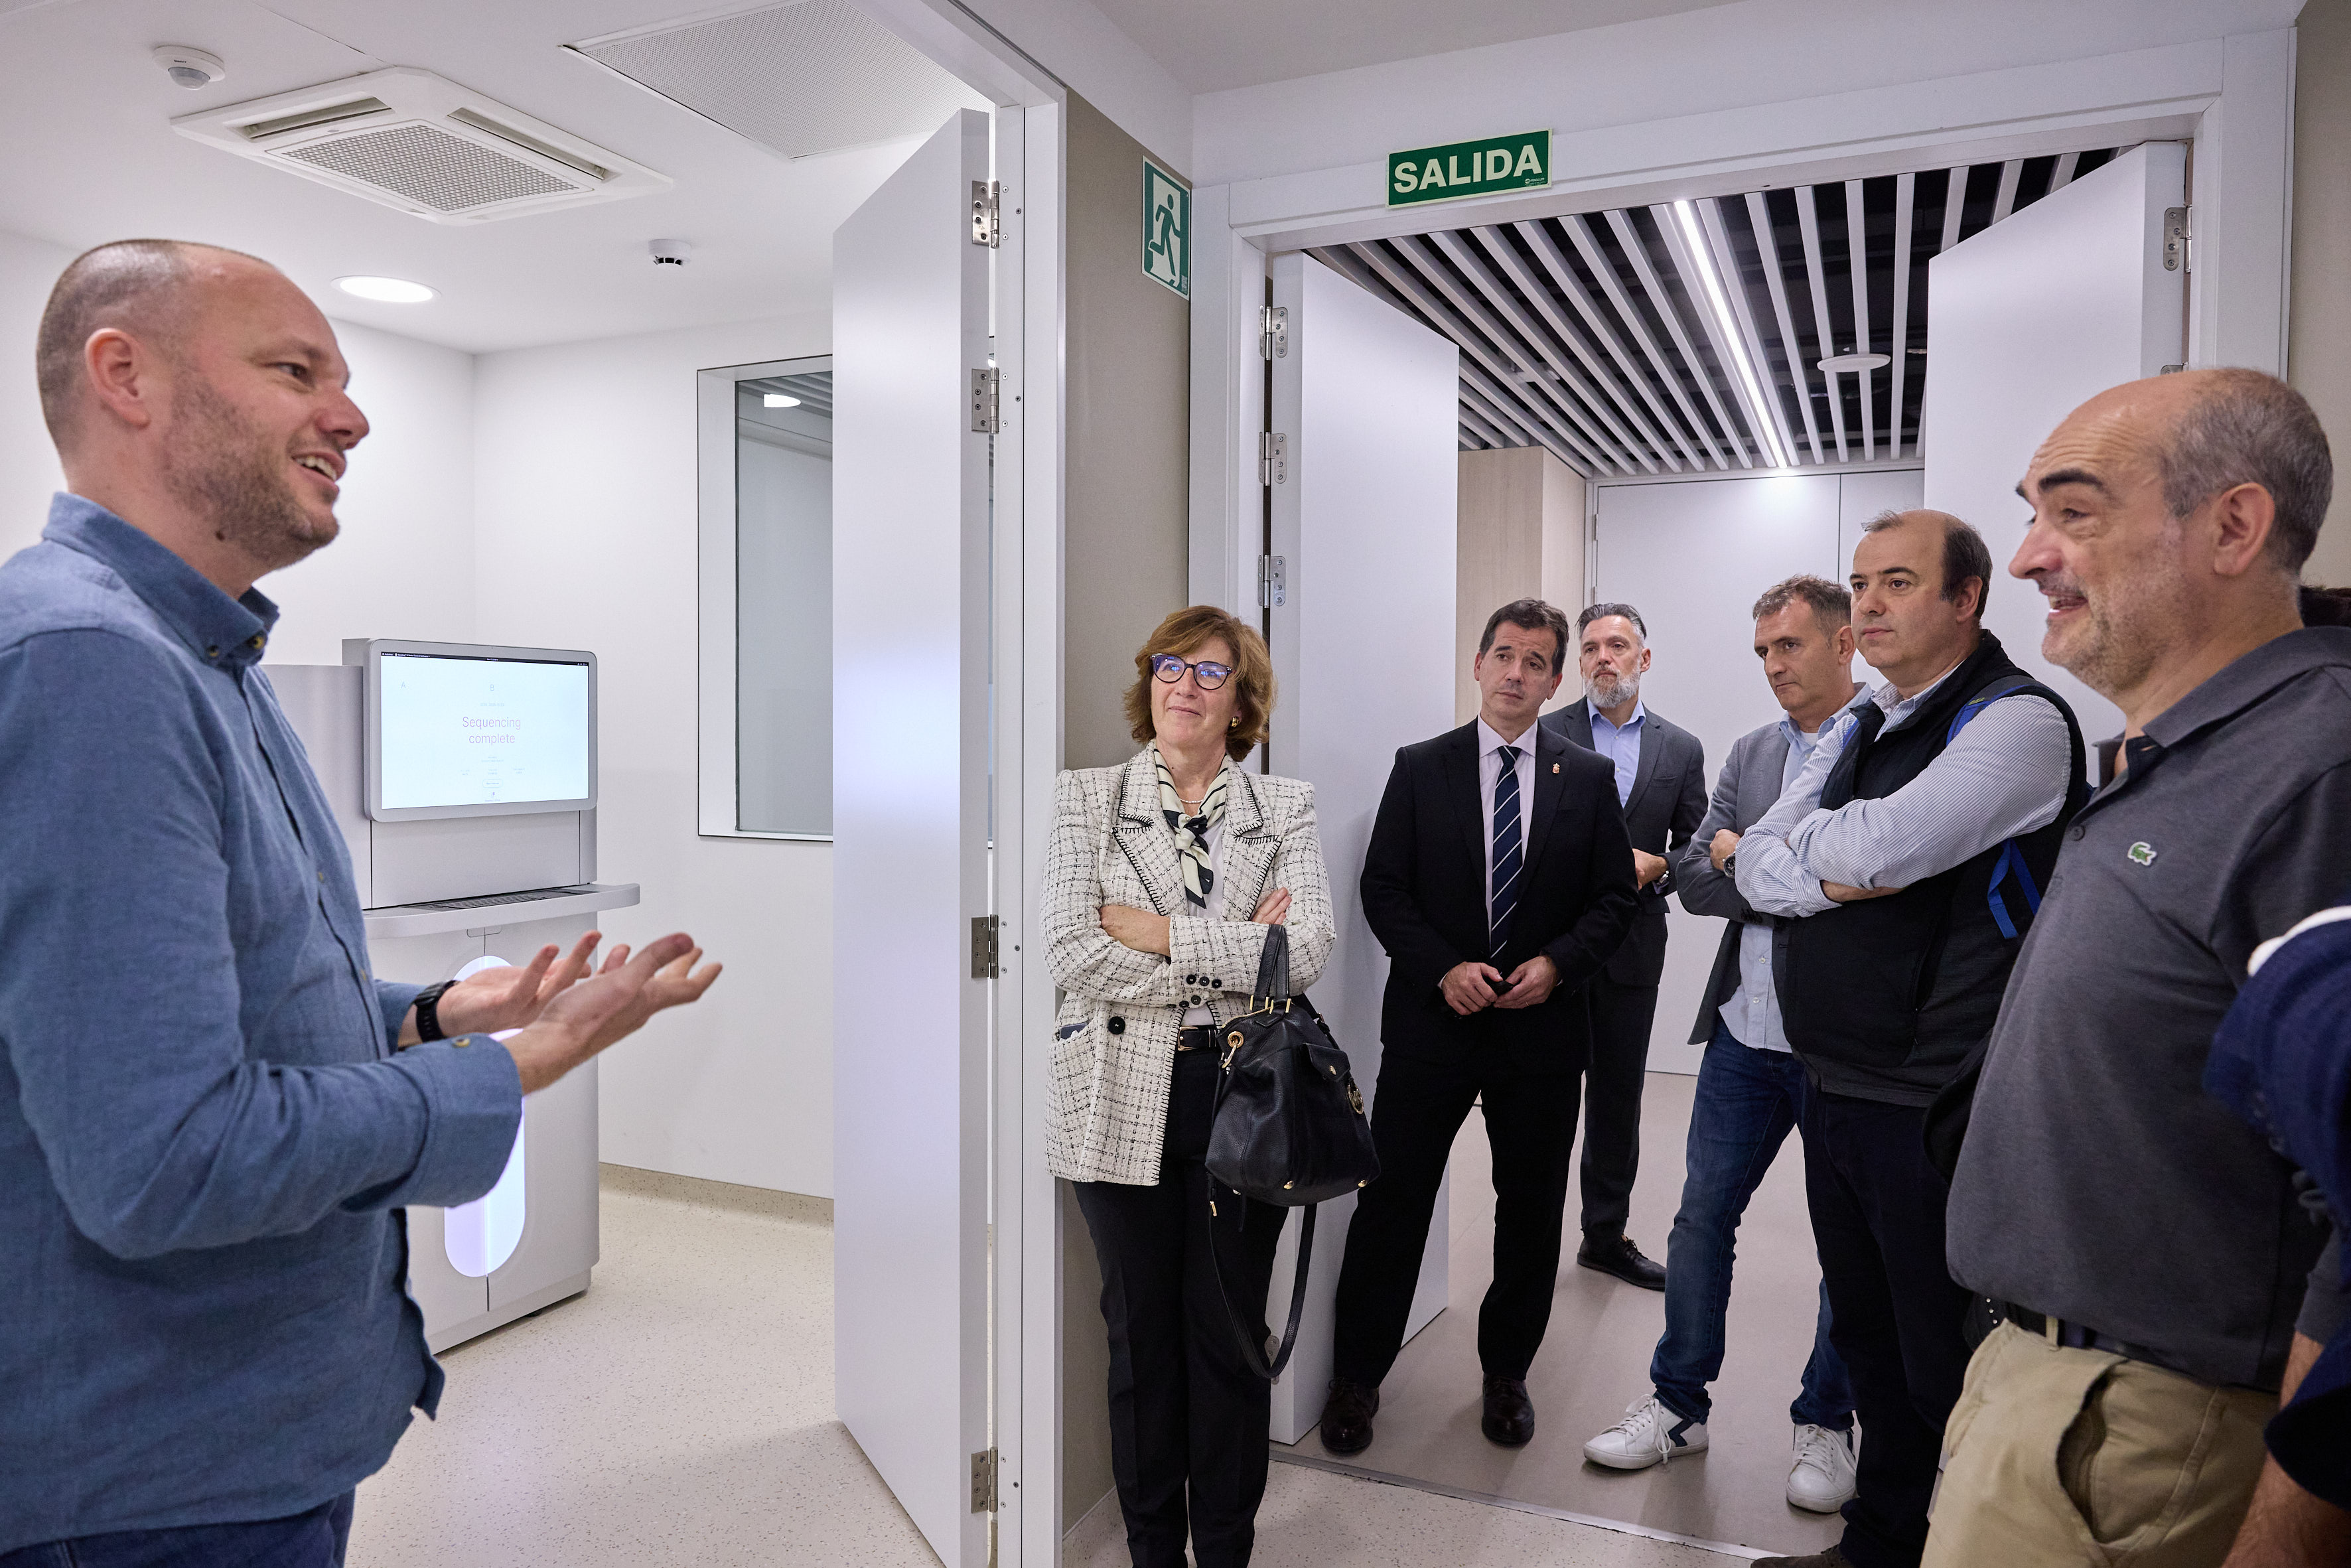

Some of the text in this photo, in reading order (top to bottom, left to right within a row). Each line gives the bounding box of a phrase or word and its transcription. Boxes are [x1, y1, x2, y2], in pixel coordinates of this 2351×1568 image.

[1393, 144, 1543, 193] SALIDA
[463, 717, 521, 730] Sequencing
[468, 733, 516, 746] complete
